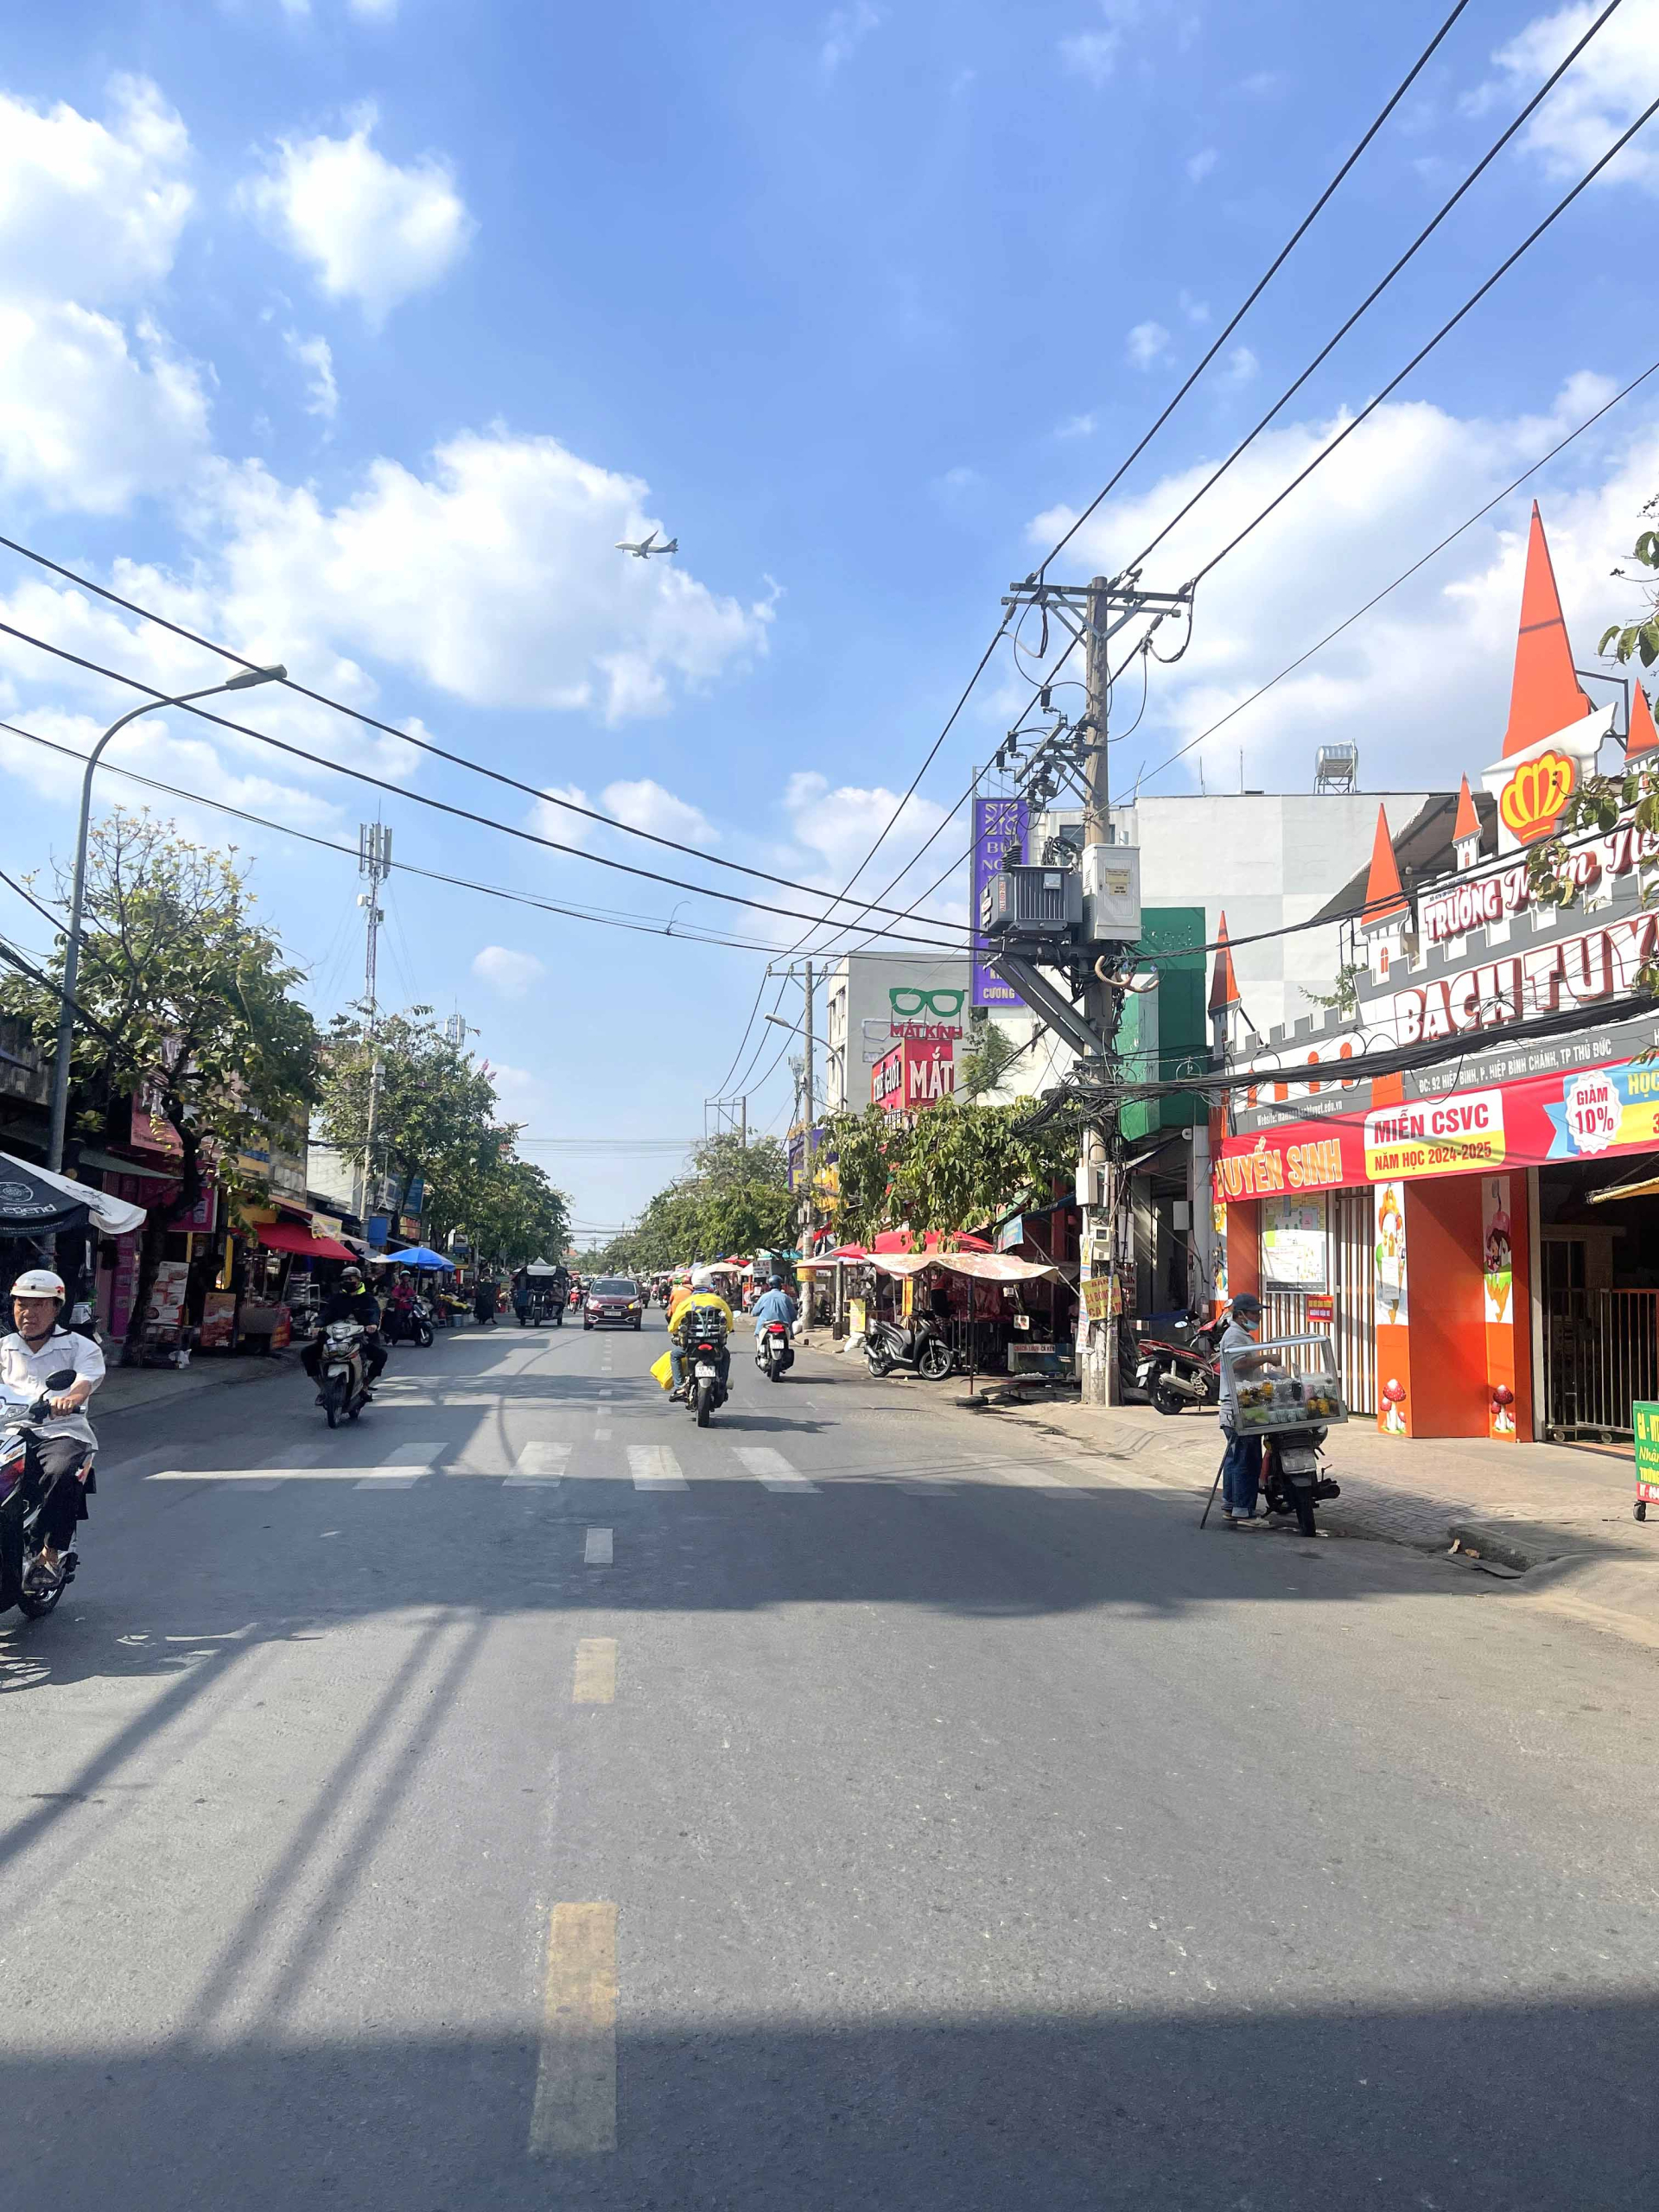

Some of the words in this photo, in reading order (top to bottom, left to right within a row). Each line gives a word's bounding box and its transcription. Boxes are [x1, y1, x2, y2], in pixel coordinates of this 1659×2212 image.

[1424, 878, 1502, 942] TRƯỜNG
[1505, 850, 1600, 912] Mm
[1523, 913, 1659, 1013] TUY
[983, 987, 1015, 999] CƯƠNG
[925, 1021, 963, 1039] KÍNH
[909, 1046, 954, 1099] MẮT
[1419, 1079, 1431, 1094] ĐC:
[1432, 1076, 1440, 1091] 92
[1459, 1066, 1479, 1085] BÌNH,
[1489, 1059, 1506, 1081] HIỆP
[1508, 1056, 1527, 1076] BÌNH
[1529, 1051, 1559, 1071] CHÁNH,
[1560, 1049, 1573, 1064] TP
[1574, 1040, 1591, 1062] THỦ
[1592, 1037, 1612, 1058] ĐỨC
[1576, 1084, 1609, 1106] GIẢM
[1256, 1114, 1277, 1127] Website:
[1374, 1109, 1425, 1145] MIỄN
[1432, 1103, 1490, 1135] CSVC
[1575, 1106, 1614, 1135] 10%
[1287, 1138, 1344, 1189] SINH
[1375, 1147, 1400, 1172] NĂM
[1402, 1151, 1425, 1171] HỌC
[1427, 1141, 1492, 1164] 2024-2025
